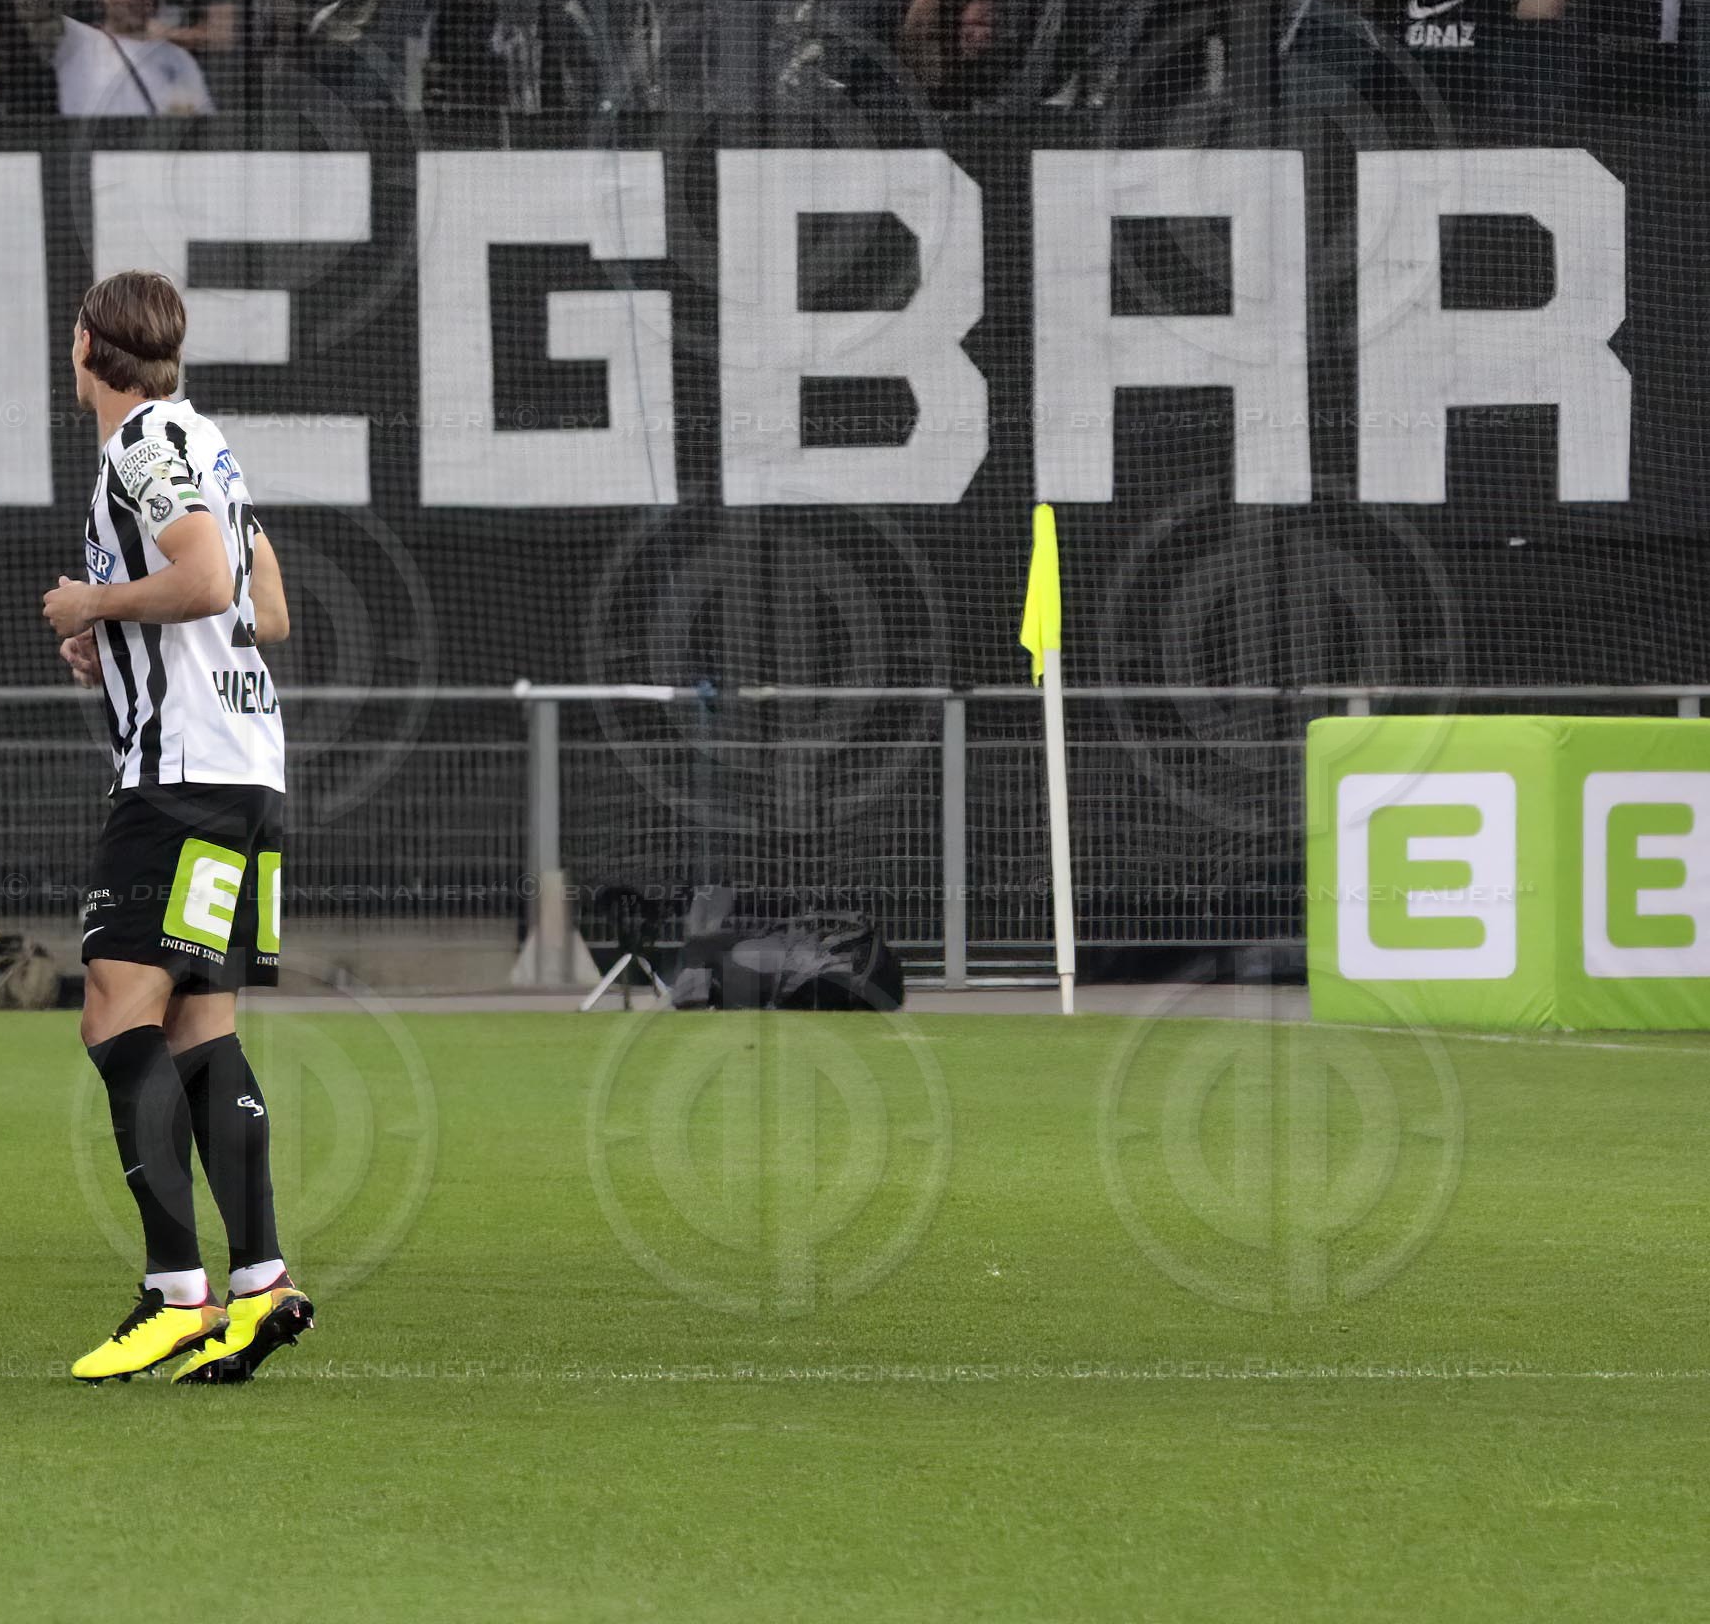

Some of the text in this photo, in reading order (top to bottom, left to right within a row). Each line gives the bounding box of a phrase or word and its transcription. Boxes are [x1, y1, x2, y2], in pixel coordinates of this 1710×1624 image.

[183, 856, 246, 940] E
[1367, 803, 1486, 951] E
[1605, 802, 1697, 949] E
